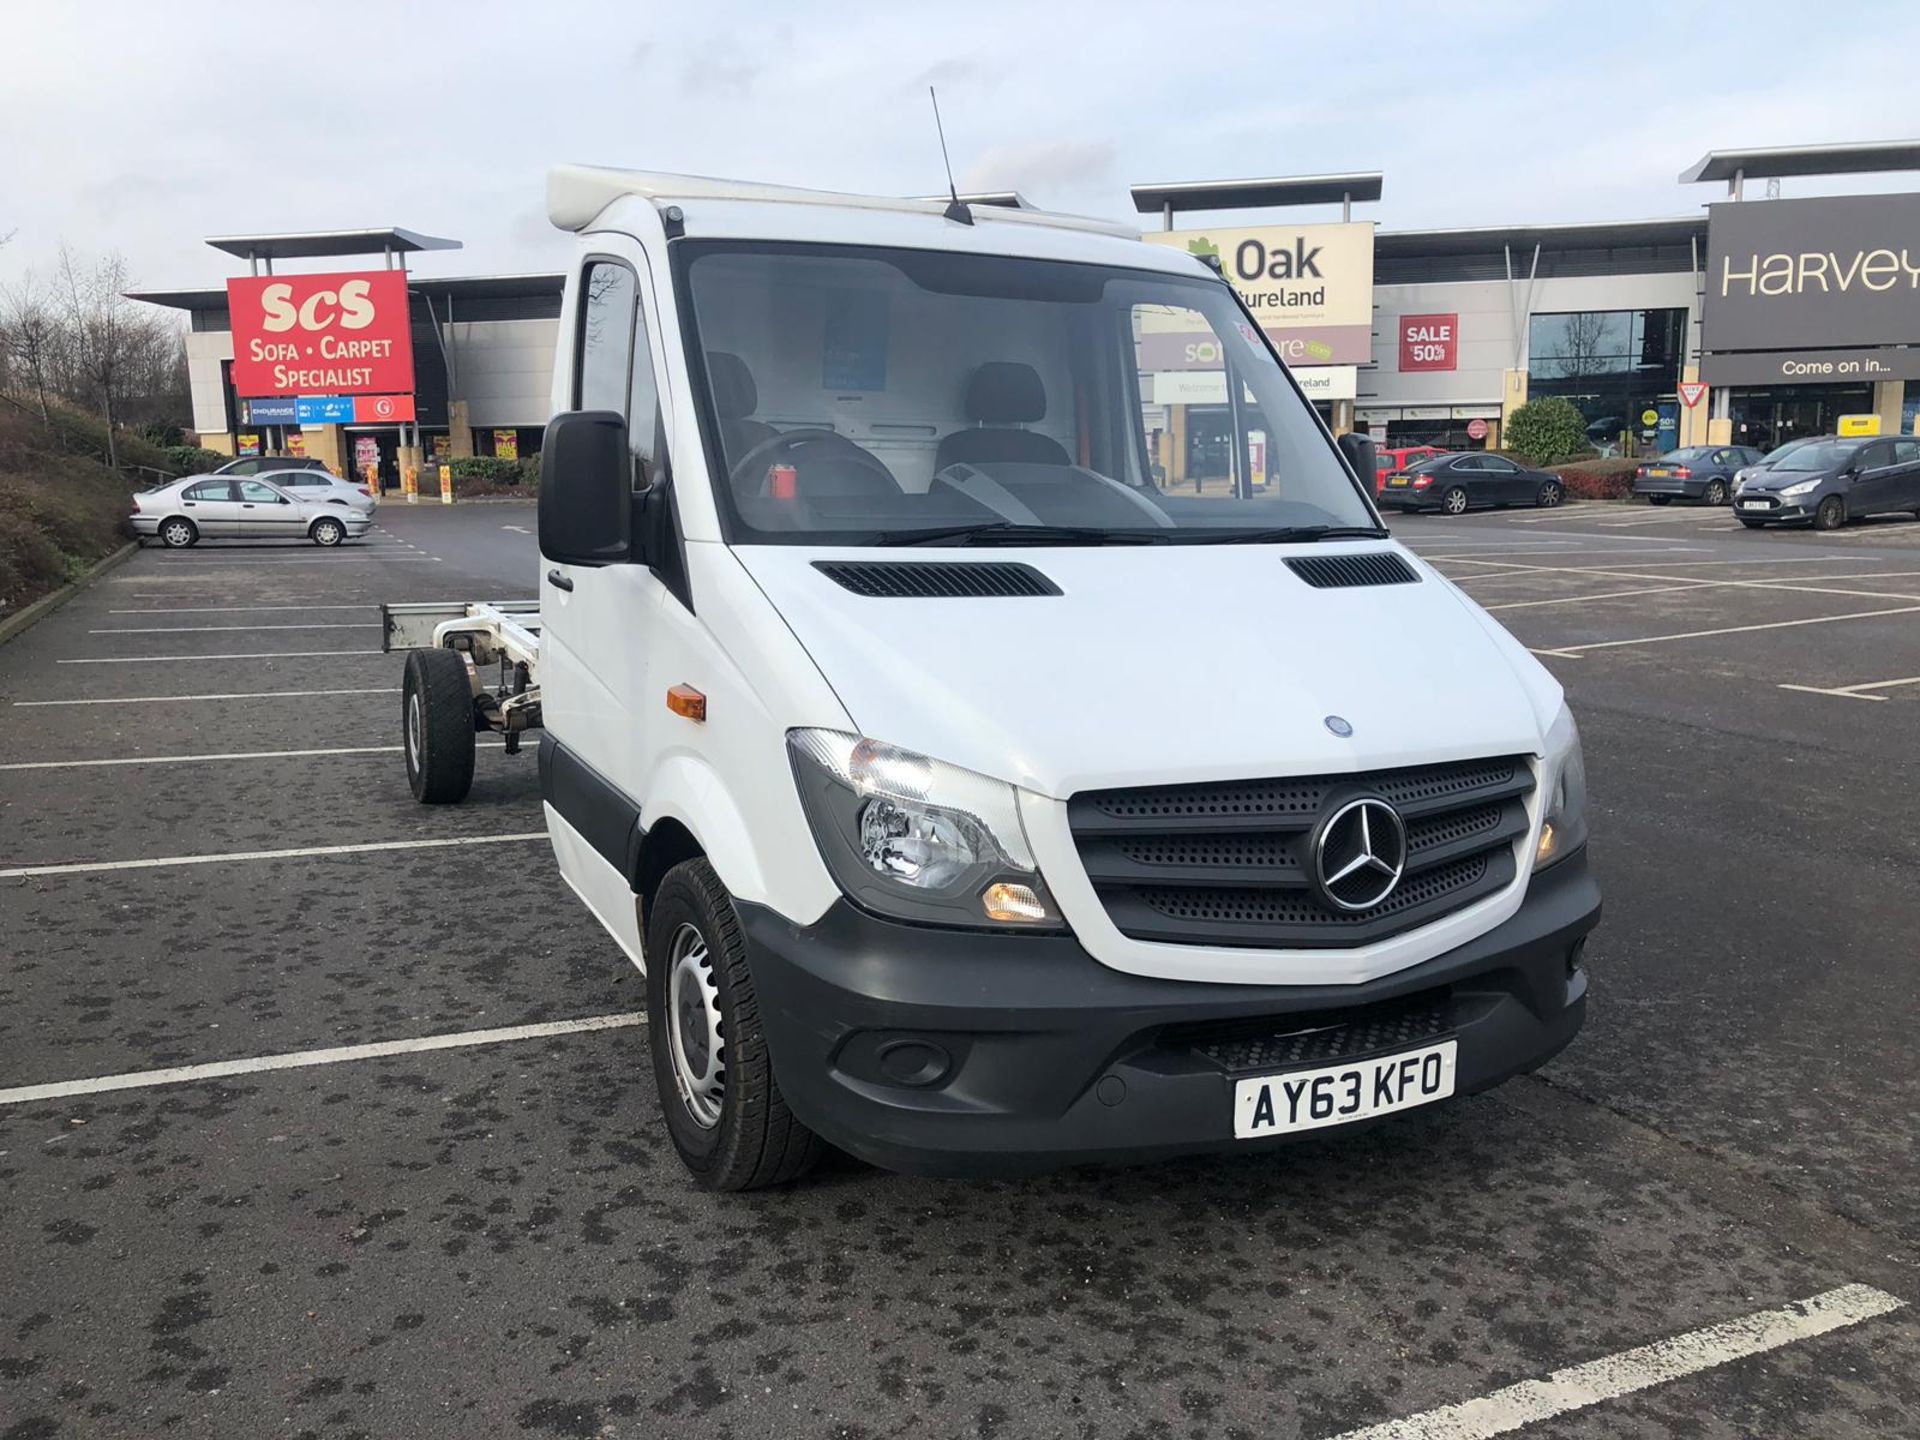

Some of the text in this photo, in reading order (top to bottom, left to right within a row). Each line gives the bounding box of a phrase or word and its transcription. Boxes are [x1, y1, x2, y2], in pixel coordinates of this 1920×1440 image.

[1236, 237, 1325, 281] Oak
[1407, 326, 1450, 342] SALE
[250, 335, 392, 362] SOFA CARPET
[274, 365, 372, 388] SPECIALIST
[1783, 358, 1891, 375] Come on in...
[1251, 1053, 1441, 1129] AY63 KFO
